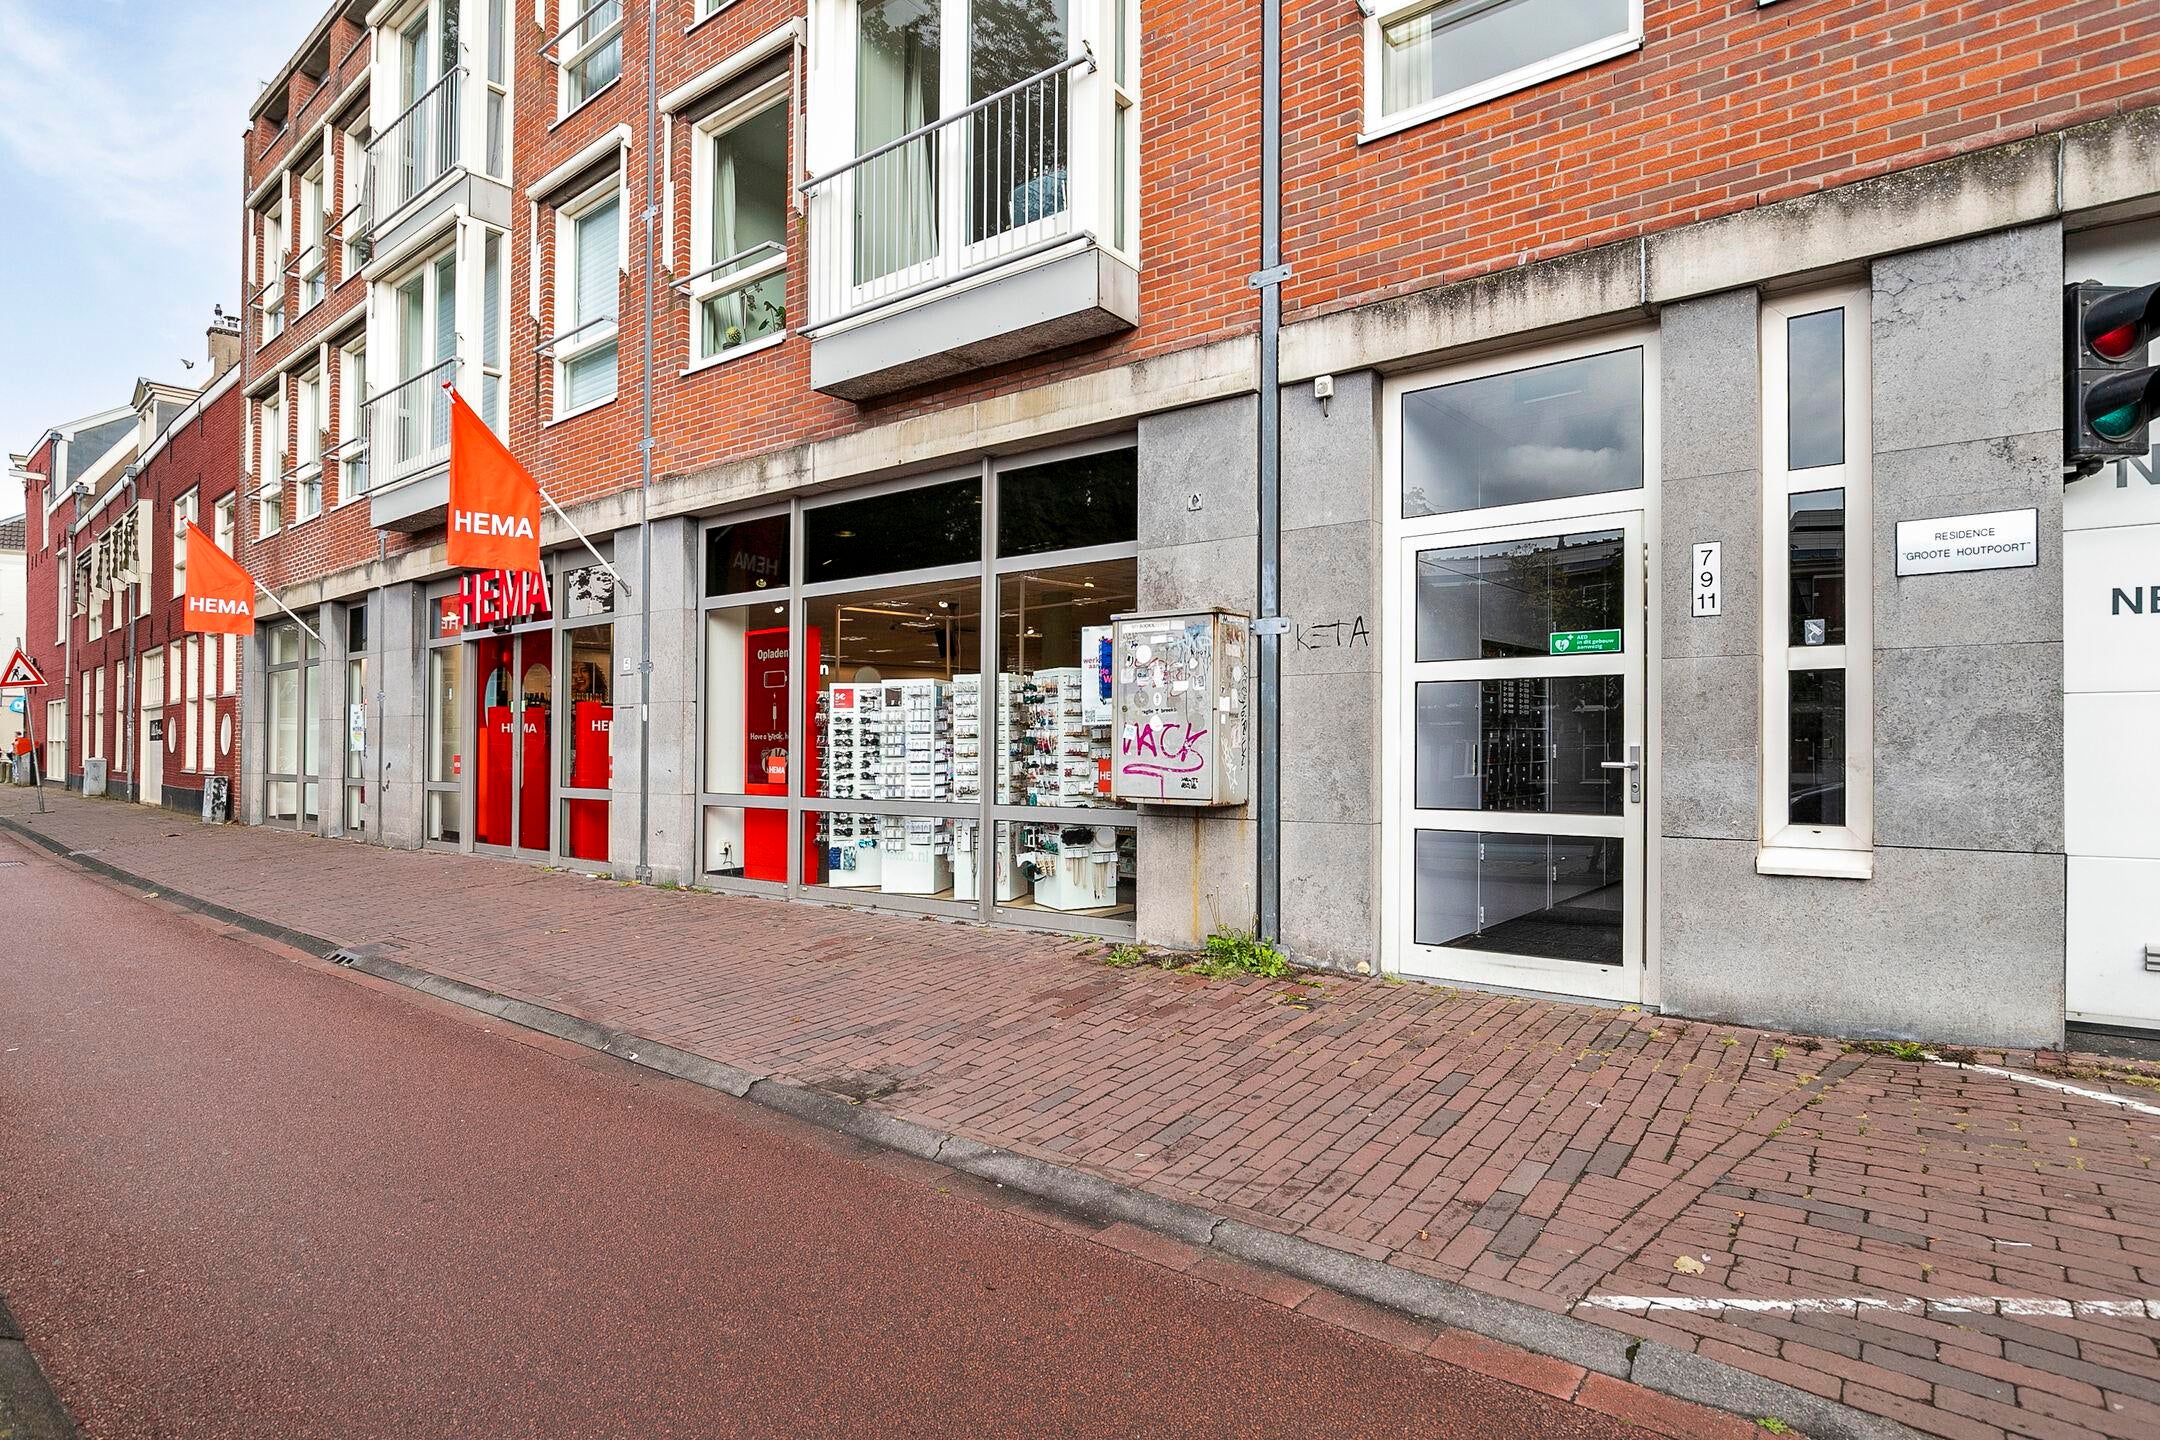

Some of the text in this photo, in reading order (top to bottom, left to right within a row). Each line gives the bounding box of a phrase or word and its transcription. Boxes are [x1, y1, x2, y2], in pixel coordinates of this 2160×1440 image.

[454, 509, 534, 539] HEMA
[1934, 527, 1996, 541] RESIDENCE
[1700, 549, 1713, 566] 7
[1700, 571, 1713, 588] 9
[458, 560, 552, 626] HEMA
[1697, 593, 1715, 609] 11
[189, 596, 250, 615] HEMA
[1296, 615, 1370, 651] KETA
[757, 648, 789, 661] Opladen
[591, 719, 611, 731] HE
[768, 765, 785, 774] HEMA
